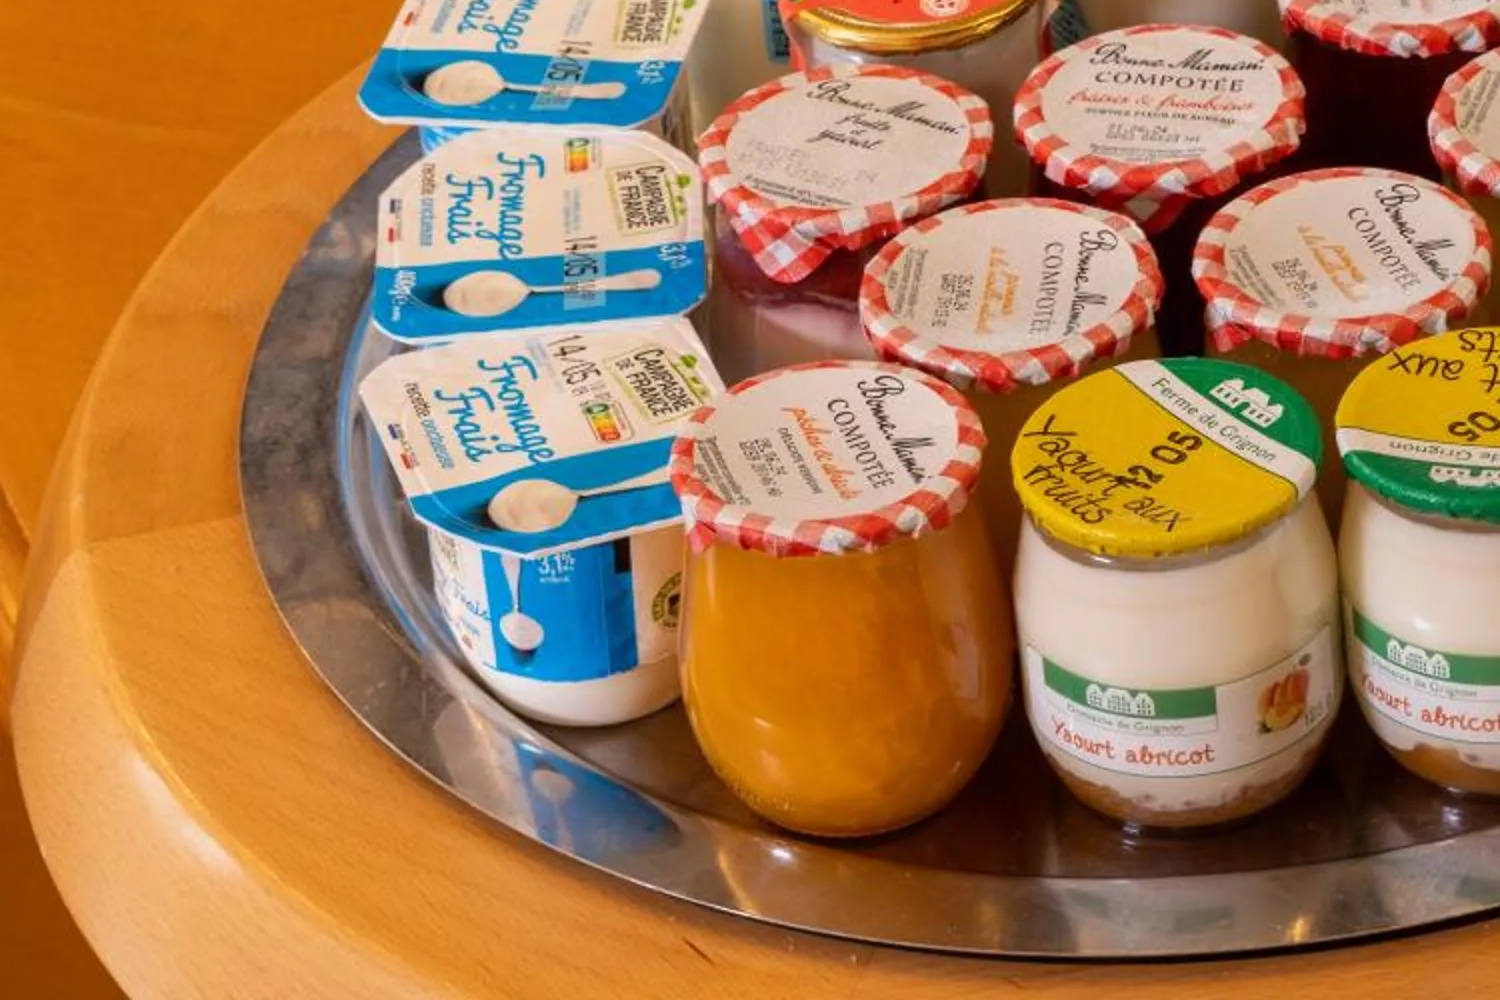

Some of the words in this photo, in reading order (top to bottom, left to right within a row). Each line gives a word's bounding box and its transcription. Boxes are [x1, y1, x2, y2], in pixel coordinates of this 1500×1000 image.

[1089, 42, 1167, 67] Bonne
[1167, 48, 1258, 72] Maman
[1094, 71, 1245, 93] COMPOTÉE
[806, 80, 876, 112] Bonne
[497, 152, 545, 259] Fromage
[616, 170, 632, 184] DE
[618, 184, 649, 230] FRANCE
[635, 165, 671, 227] CAMPAGNE
[447, 173, 494, 245] Frais
[1375, 184, 1421, 243] Bonne
[564, 234, 599, 277] 14/05
[1074, 229, 1118, 291] Bonne
[1347, 206, 1420, 292] COMPOTÉE
[1030, 241, 1065, 340] COMPOTÉE
[548, 335, 602, 386] 14/05
[616, 358, 636, 372] DE
[628, 372, 675, 417] FRANCE
[633, 348, 695, 414] CAMPAGNE
[1388, 351, 1465, 381] aux
[405, 382, 432, 419] recette
[434, 387, 499, 463] Frais
[477, 354, 556, 464] Fromage
[857, 375, 904, 440] Bonne
[890, 436, 936, 485] Maman
[1151, 376, 1200, 417] Ferme
[1199, 410, 1220, 430] de
[1220, 425, 1278, 464] Grignon
[827, 399, 896, 490] COMPOTÉE
[1023, 414, 1128, 498] Yaourt
[1123, 496, 1192, 533] aux
[1151, 430, 1203, 465] 05
[1389, 440, 1472, 462] Grignon
[1023, 464, 1114, 525] fruits
[1051, 714, 1115, 760] Yaourt
[1125, 743, 1216, 766] abricot
